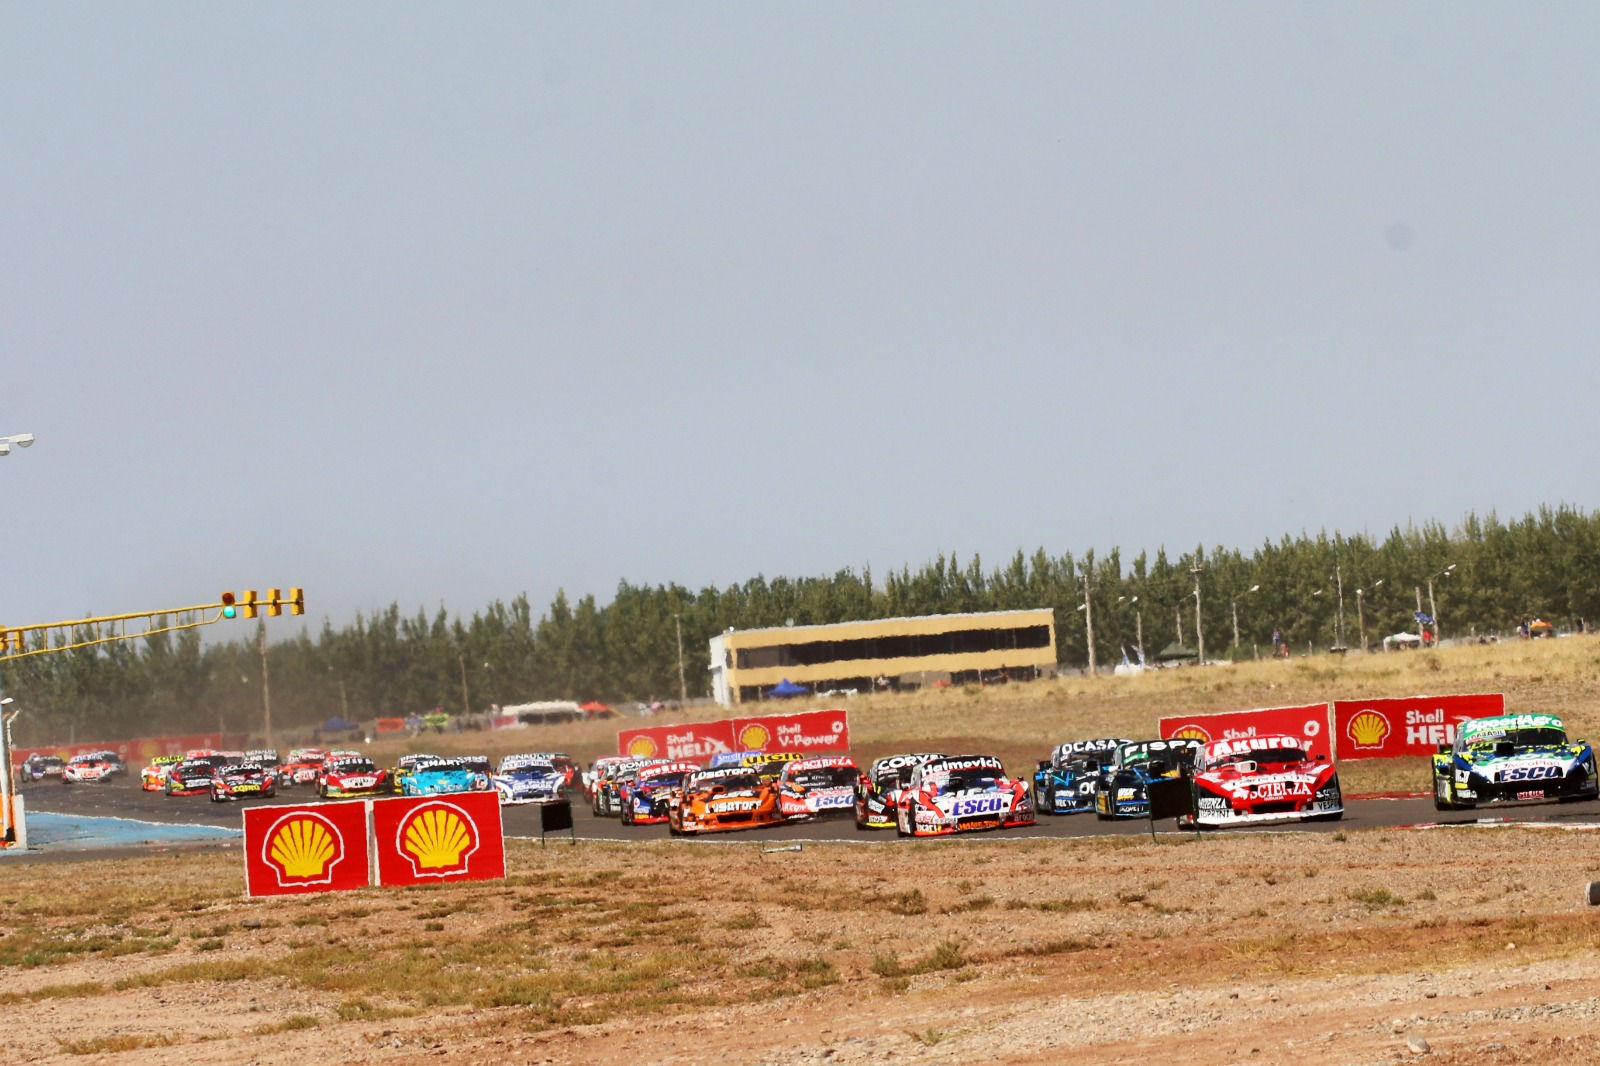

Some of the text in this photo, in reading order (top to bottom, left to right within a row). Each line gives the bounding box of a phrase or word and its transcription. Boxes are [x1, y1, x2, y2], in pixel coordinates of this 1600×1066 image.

[1406, 709, 1444, 724] Shell
[1465, 715, 1562, 733] SpeedAgro
[776, 724, 801, 735] Shell
[667, 732, 694, 745] Shell
[778, 735, 839, 747] V-Power
[1213, 736, 1298, 757] Akuro
[1061, 739, 1117, 755] OCASA
[1124, 741, 1200, 758] FISPA
[1500, 766, 1560, 783] ESCO
[815, 795, 855, 807] ESCO
[952, 798, 1002, 816] ESCO
